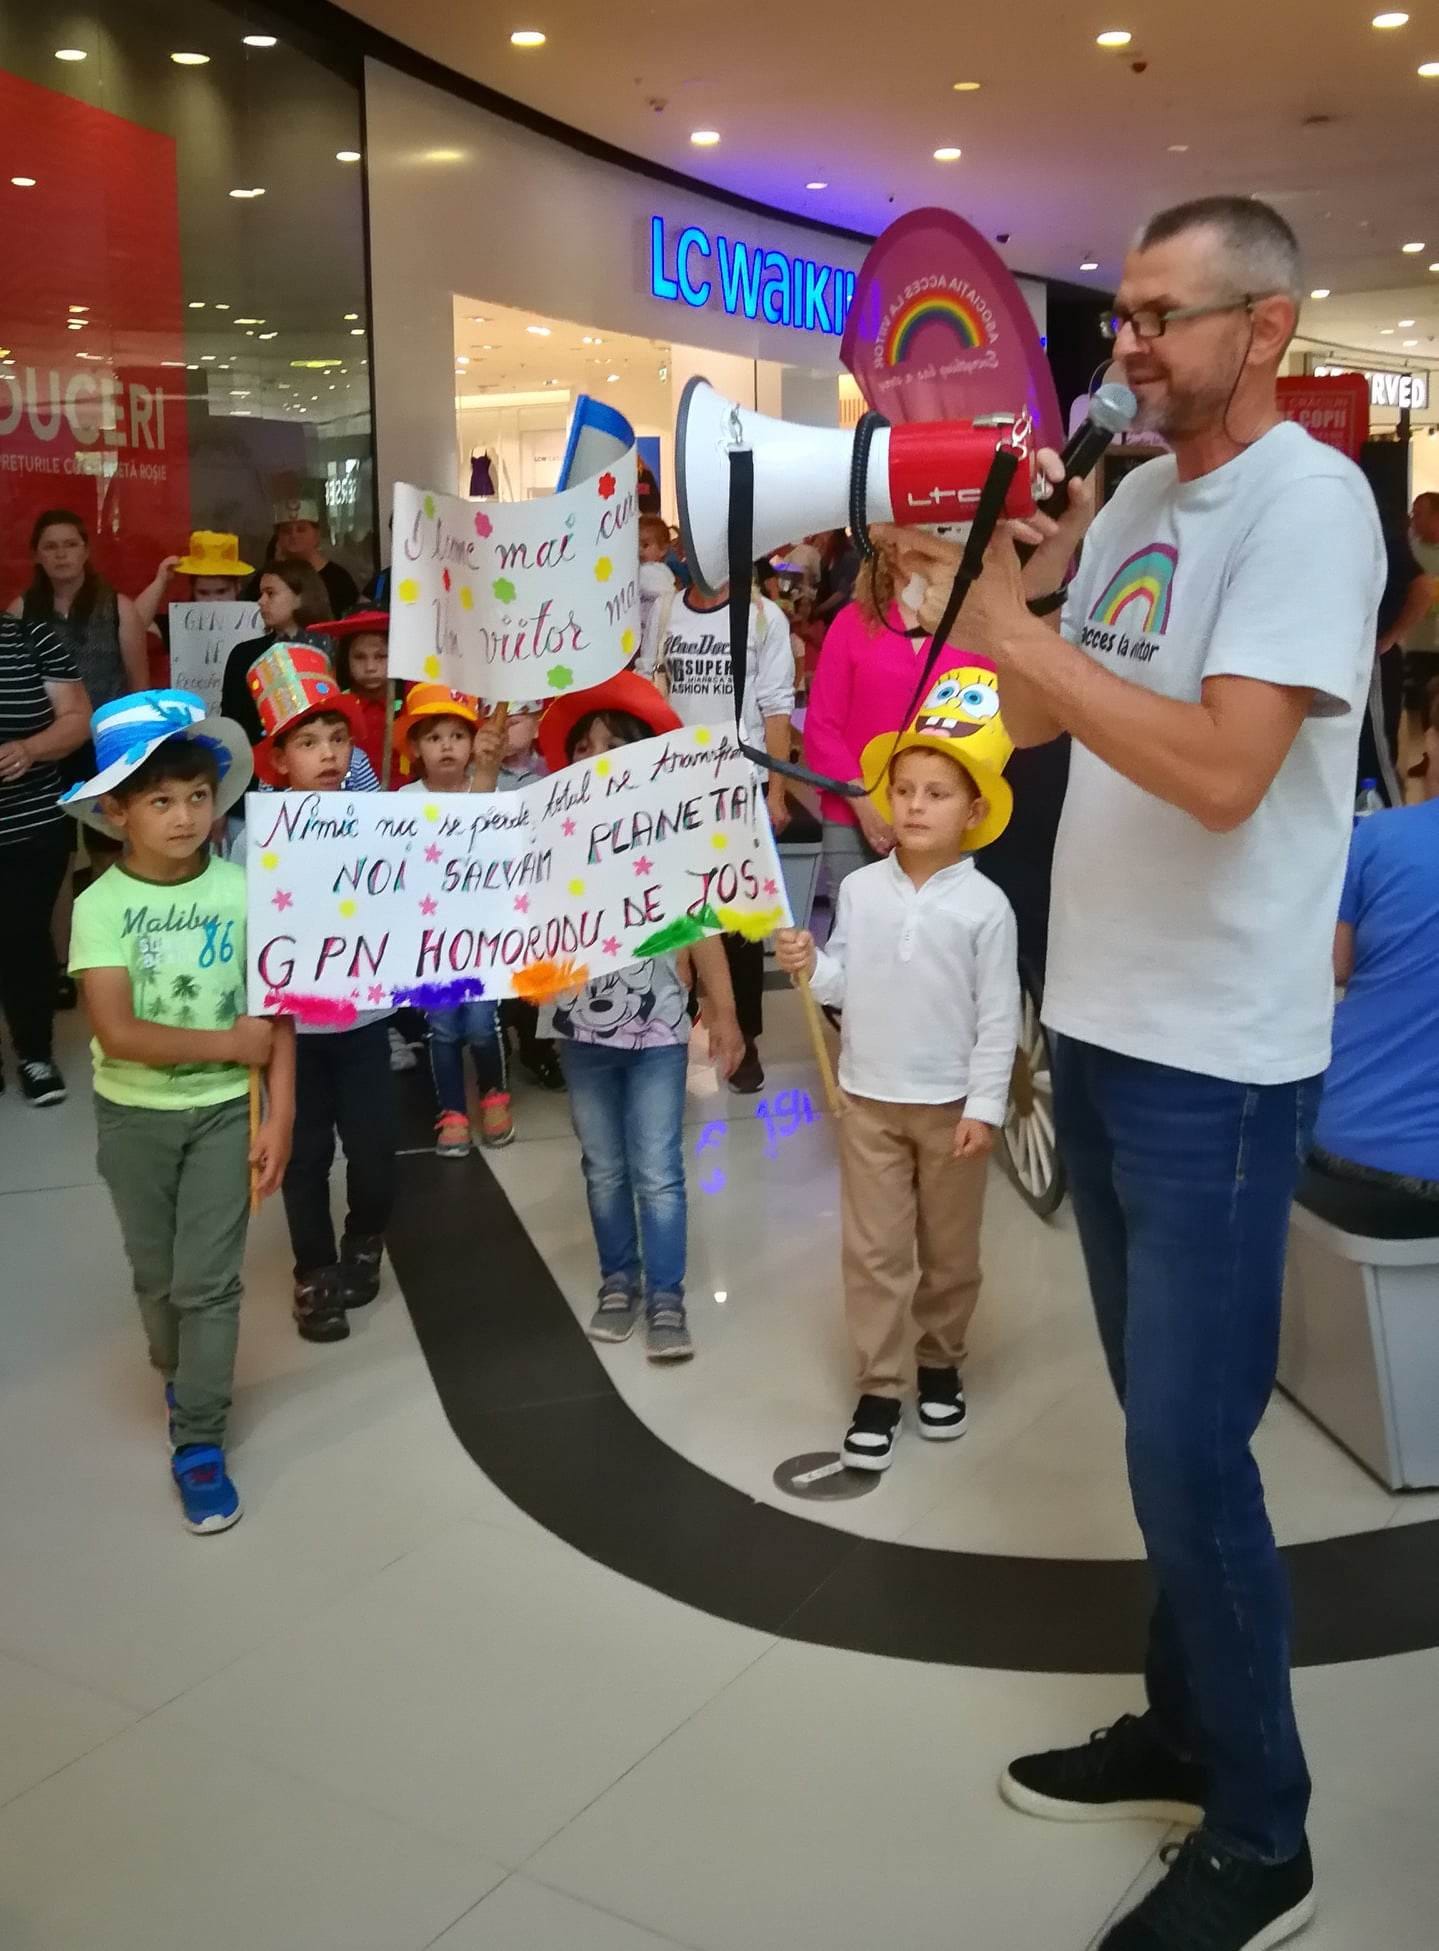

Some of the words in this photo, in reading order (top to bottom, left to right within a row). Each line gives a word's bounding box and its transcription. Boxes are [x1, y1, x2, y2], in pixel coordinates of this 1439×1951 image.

[652, 216, 712, 308] LC
[493, 512, 577, 570] mai
[255, 793, 359, 848] Nimic
[375, 815, 419, 838] nu
[623, 883, 666, 940] DE
[198, 919, 235, 969] 86
